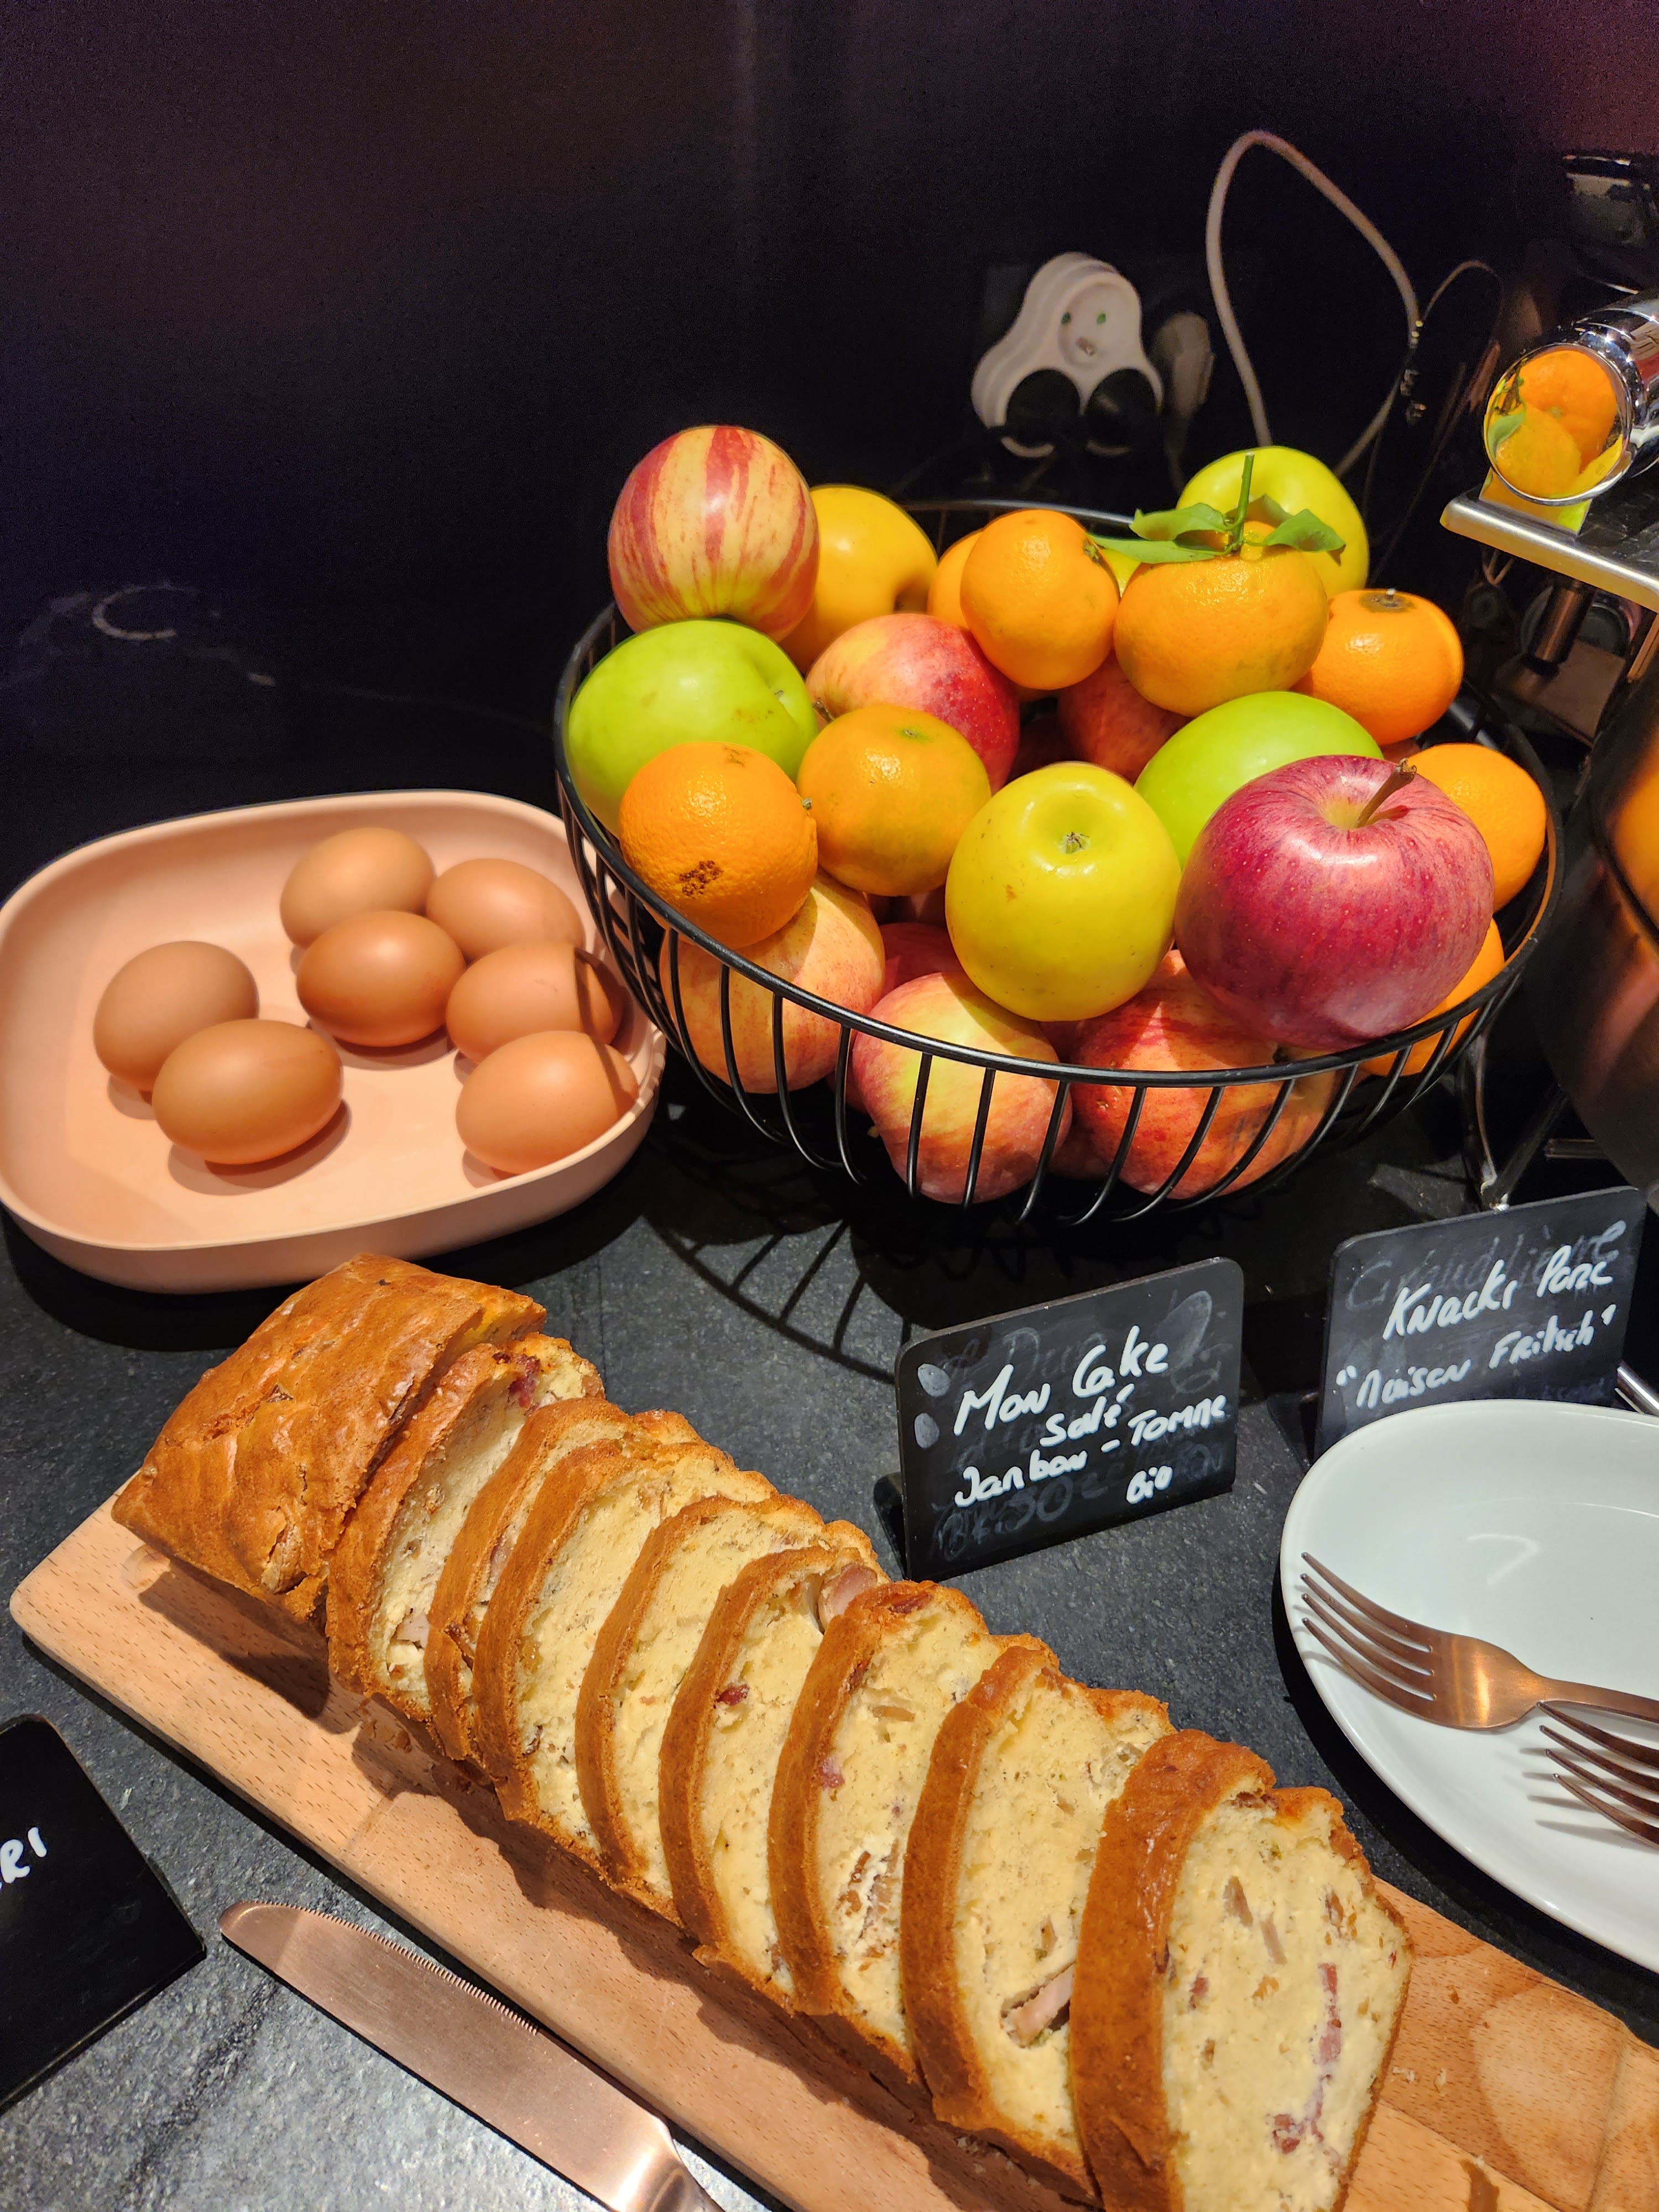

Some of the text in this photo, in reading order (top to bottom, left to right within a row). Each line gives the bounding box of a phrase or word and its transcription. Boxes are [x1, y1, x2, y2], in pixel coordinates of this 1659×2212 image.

[953, 1363, 1051, 1436] Mon
[1072, 1324, 1168, 1398] Cake
[1126, 1465, 1173, 1505] Bio
